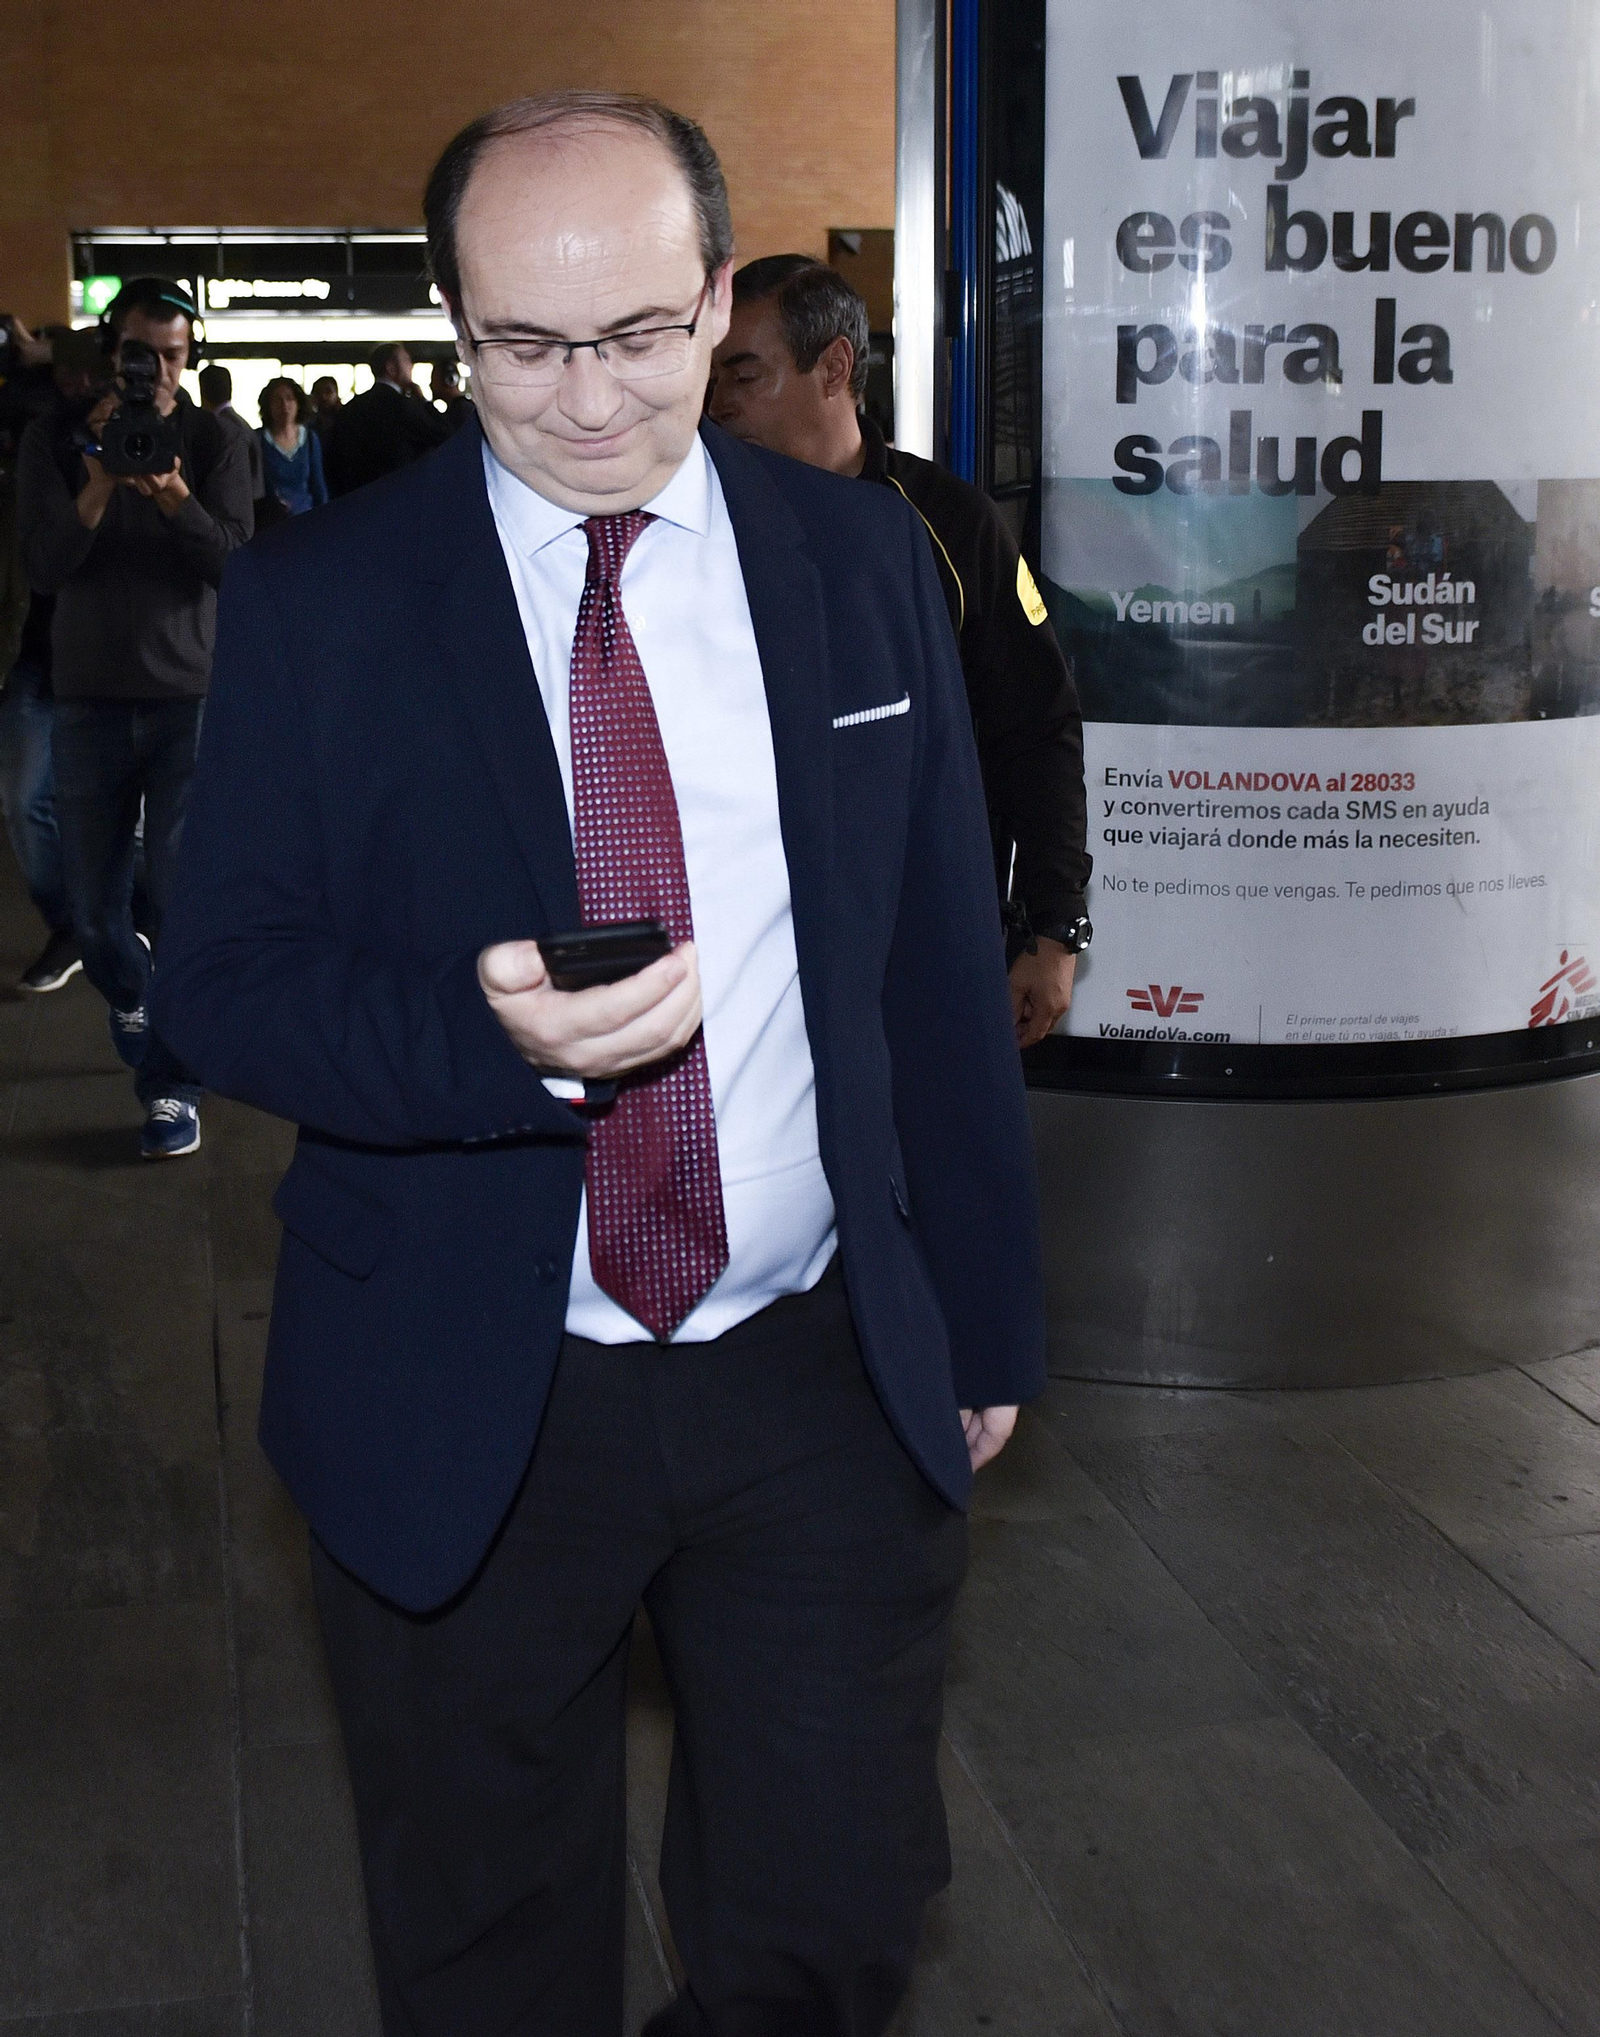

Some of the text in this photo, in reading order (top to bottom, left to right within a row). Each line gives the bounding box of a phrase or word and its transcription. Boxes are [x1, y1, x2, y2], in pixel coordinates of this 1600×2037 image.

[1116, 70, 1416, 181] Viajar
[1115, 184, 1557, 274] es bueno
[1116, 298, 1454, 404] para la
[1112, 410, 1383, 497] salud
[1367, 572, 1477, 607] Sudán
[1109, 591, 1235, 626] Yemen
[1362, 613, 1480, 645] del Sur
[1104, 767, 1416, 792] Envía VOLANDOVA al 28033
[1103, 796, 1490, 822] y convertiremos cada SMS en ayuda
[1103, 827, 1480, 850] que viajará donde más la necesiten.
[1102, 872, 1548, 902] No te pedimos que vengas. Te pedimos que nos lleves.
[1098, 1023, 1231, 1043] VolandoVa.com
[1285, 1032, 1299, 1041] en
[1302, 1030, 1312, 1041] el
[1314, 1031, 1336, 1043] que
[1352, 1032, 1366, 1041] no
[1404, 1029, 1415, 1039] tu
[1417, 1026, 1447, 1039] ayuda
[1286, 1013, 1420, 1027] El primer portal de viajes
